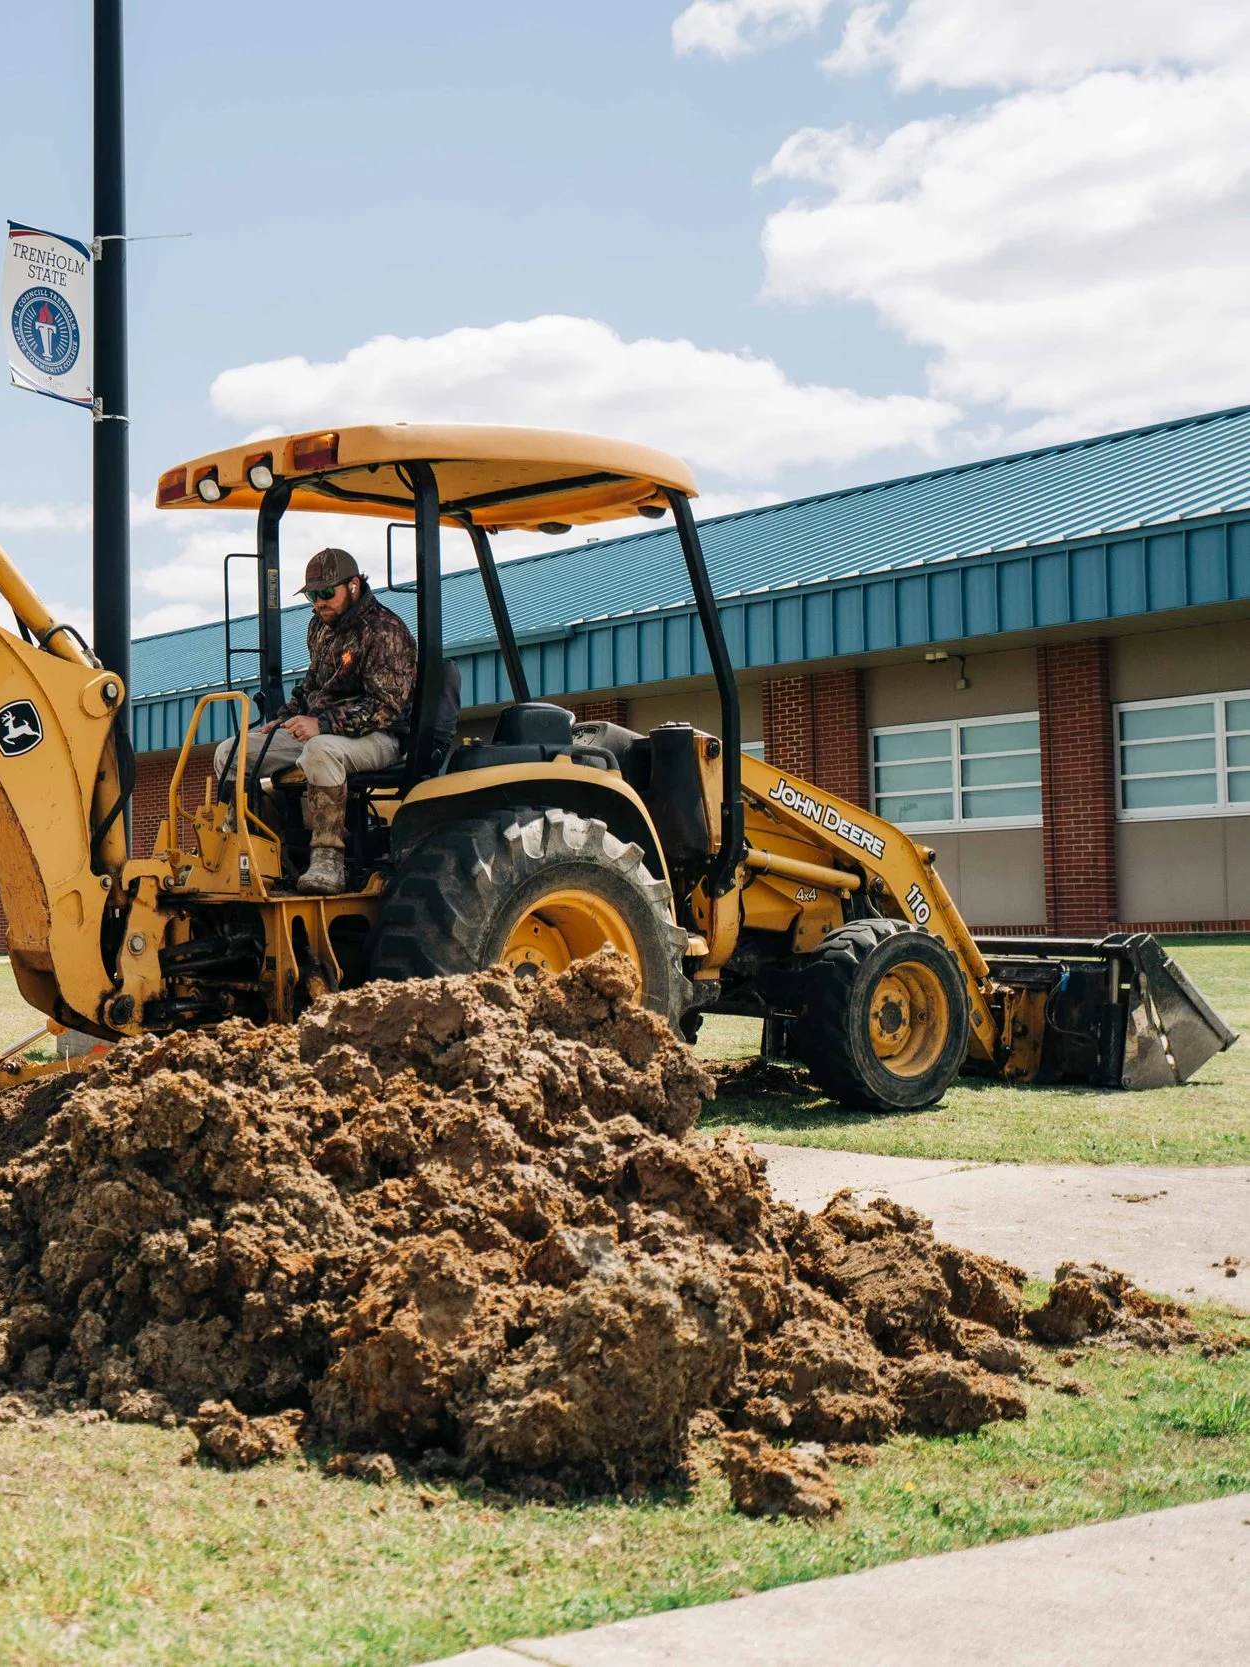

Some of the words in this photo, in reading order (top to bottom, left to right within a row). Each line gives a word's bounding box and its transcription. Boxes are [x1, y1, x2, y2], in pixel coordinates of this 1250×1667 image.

[12, 242, 85, 275] TRENHOLM
[28, 264, 67, 287] STATE
[18, 289, 48, 308] COUNCILL
[49, 291, 77, 331] TRENHOLM
[13, 326, 27, 353] STATE
[25, 351, 64, 374] COMMUNITY
[63, 340, 78, 369] COLLEGE
[769, 778, 824, 824] JOHN
[822, 805, 886, 860] DEERE
[795, 888, 817, 902] 4x4
[905, 882, 931, 925] 110
